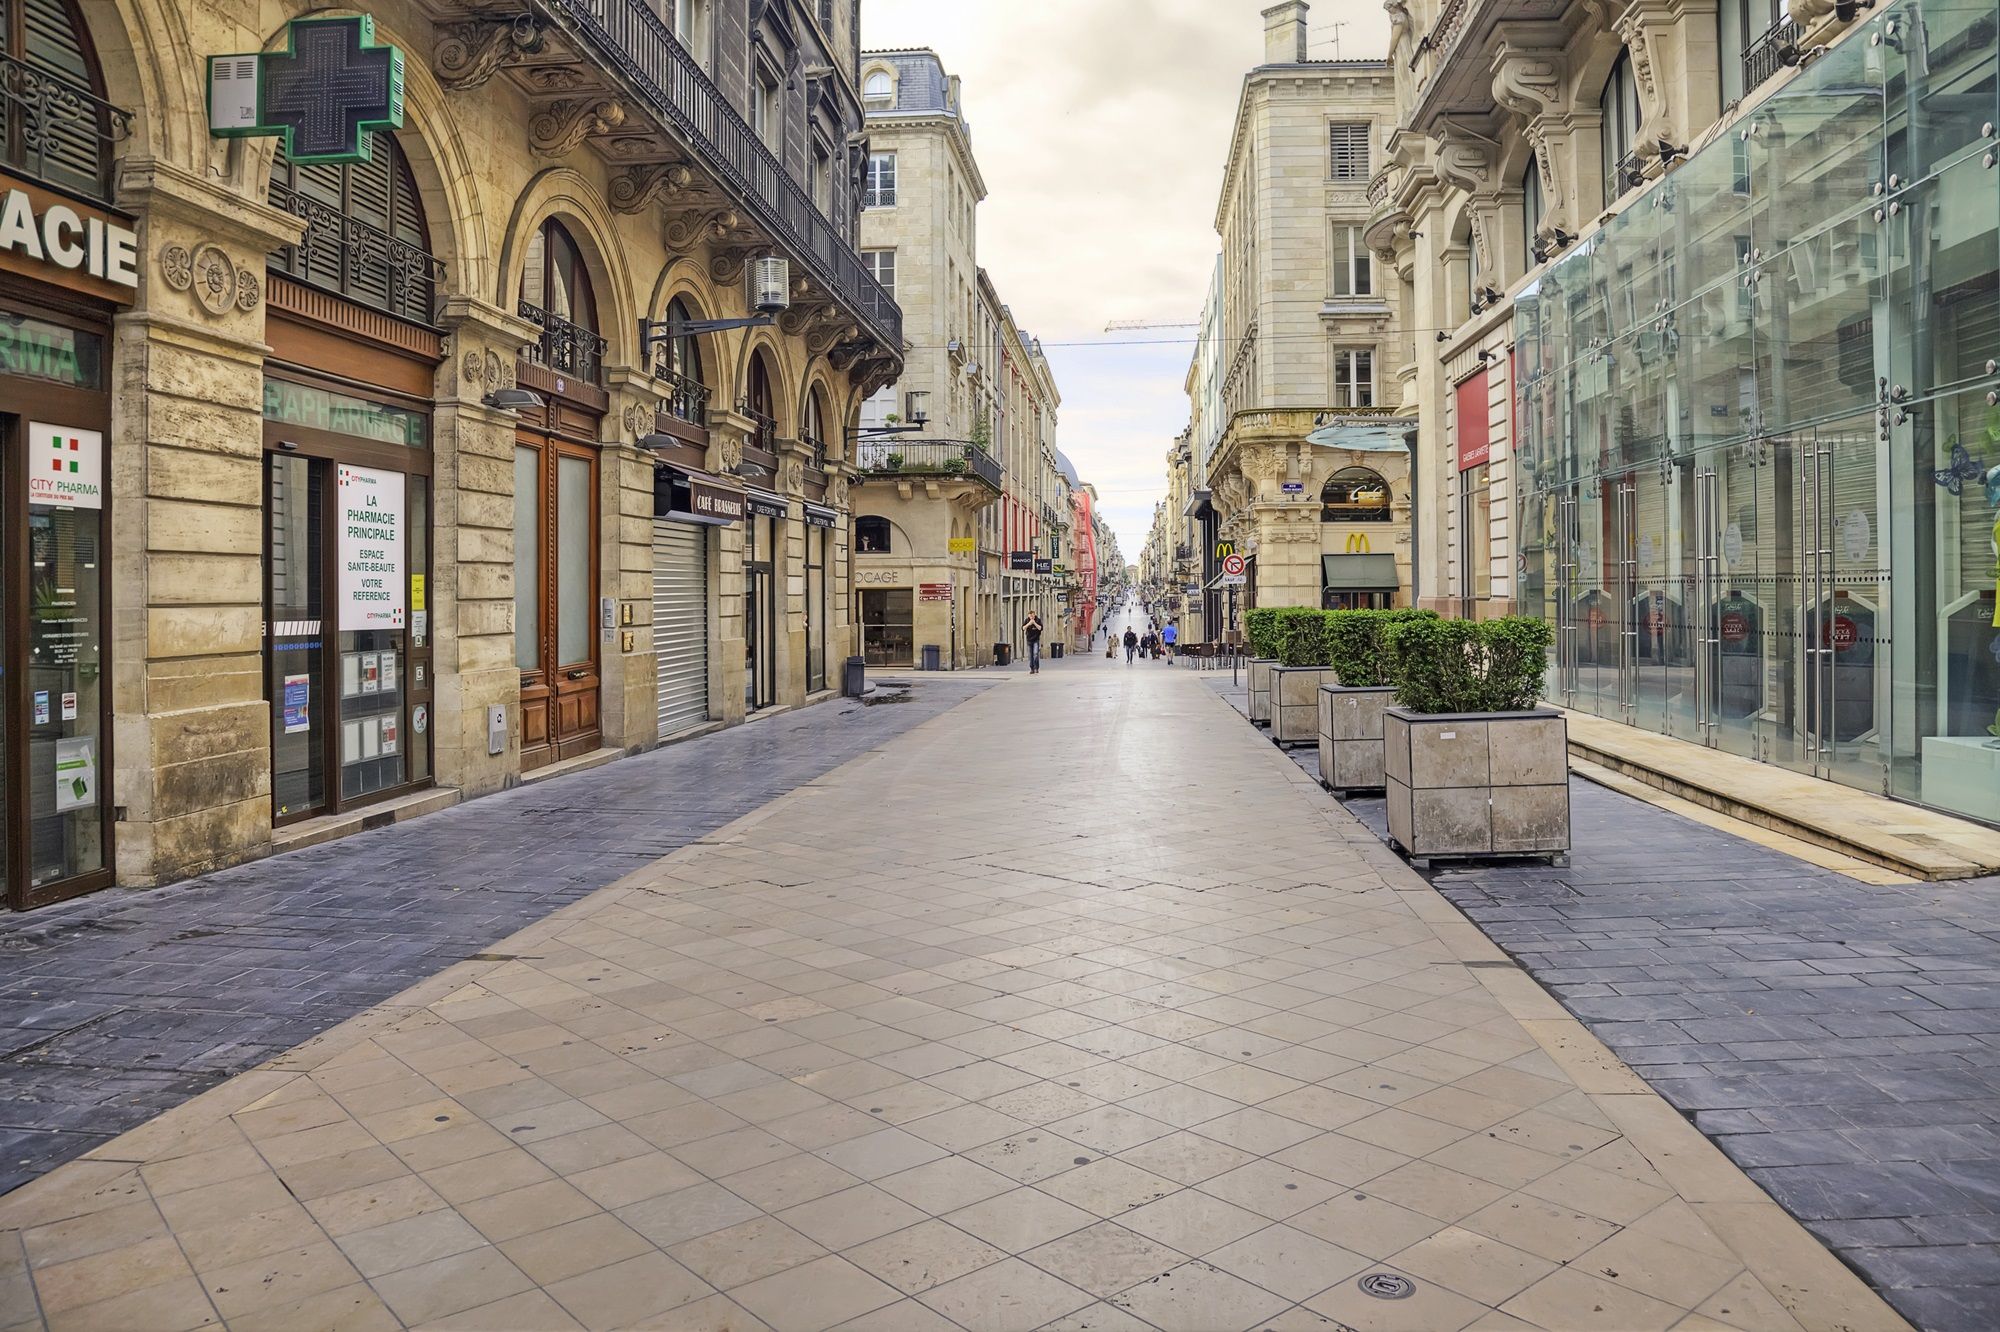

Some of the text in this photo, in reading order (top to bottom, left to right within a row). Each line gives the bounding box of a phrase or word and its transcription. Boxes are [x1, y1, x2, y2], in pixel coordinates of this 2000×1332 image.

[0, 189, 138, 288] ACIE
[30, 478, 99, 496] CITY PHARMA
[366, 495, 377, 507] LA
[697, 495, 742, 516] CAFÉ BRASSERIE
[347, 509, 395, 525] PHARMACIE
[347, 526, 395, 541] PRINCIPALE
[359, 549, 385, 559] ESPACE
[347, 561, 395, 572] SANTE-BEAUTE
[361, 578, 383, 588] VOTRE
[353, 591, 391, 601] REFERENCE
